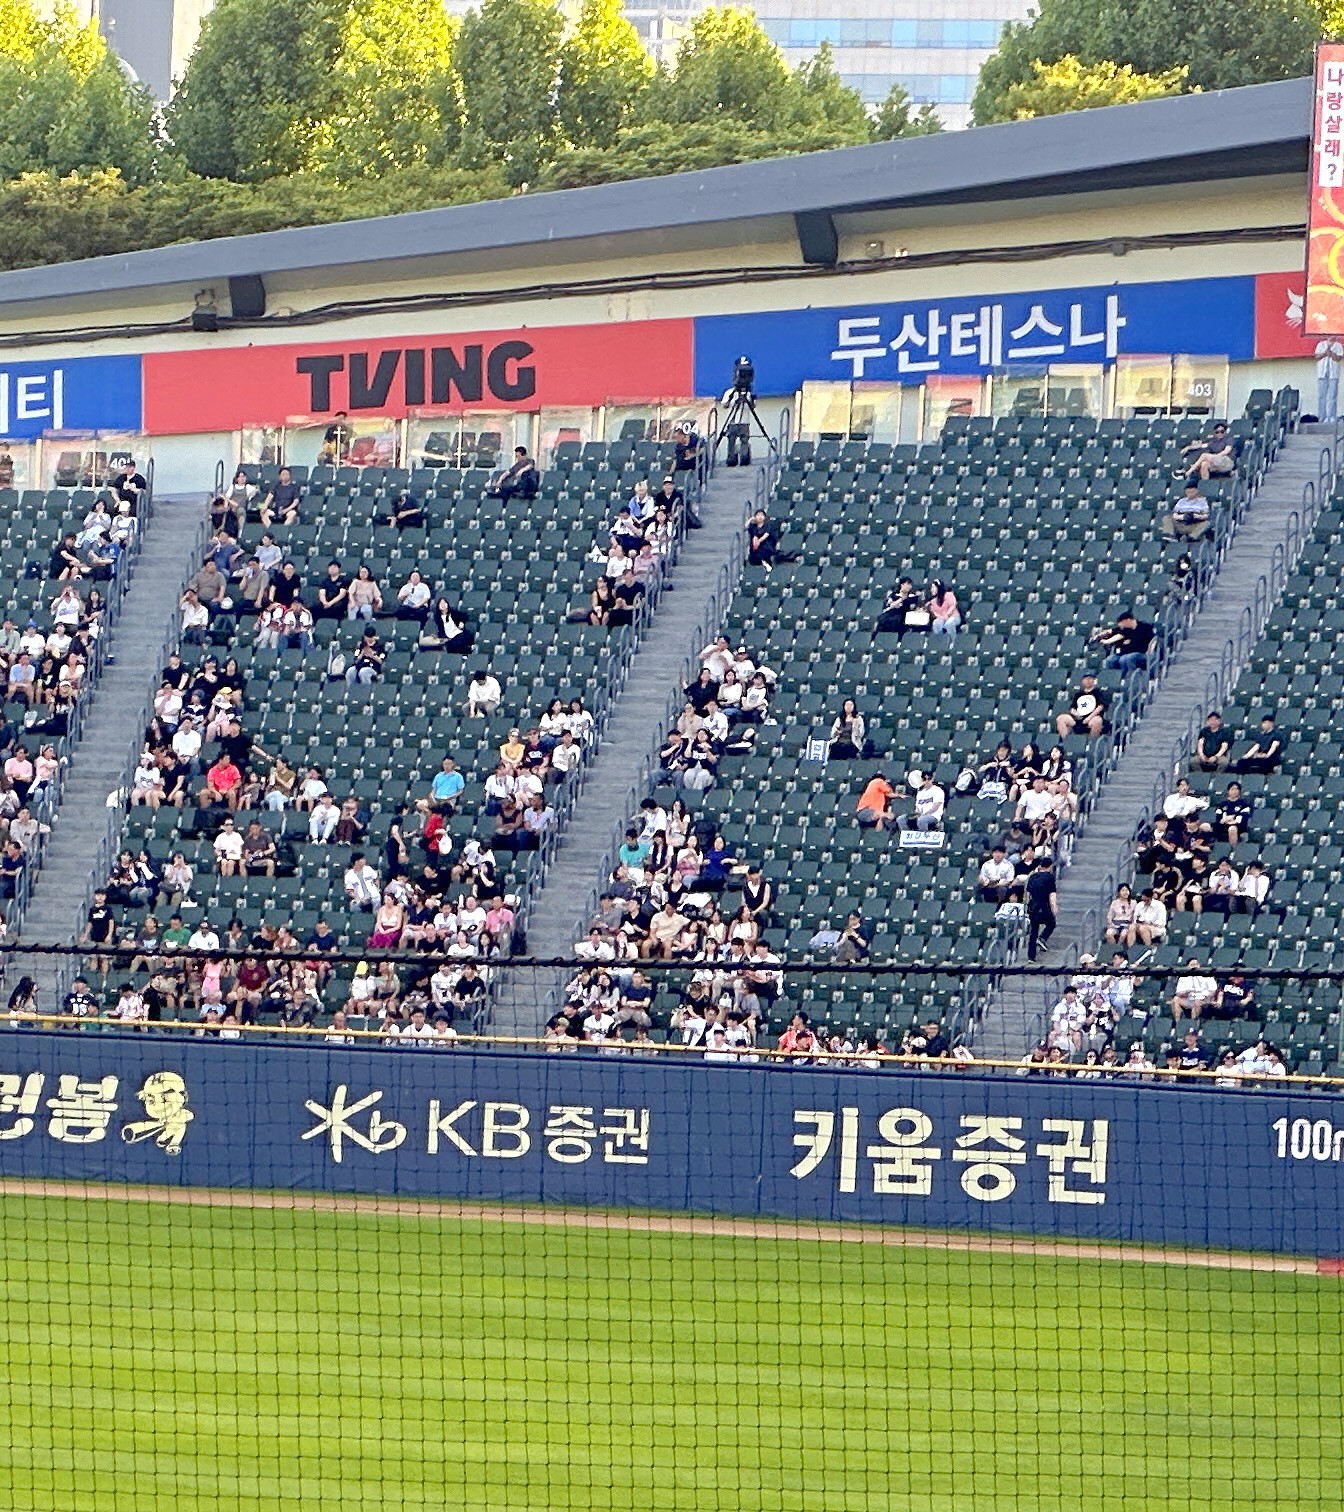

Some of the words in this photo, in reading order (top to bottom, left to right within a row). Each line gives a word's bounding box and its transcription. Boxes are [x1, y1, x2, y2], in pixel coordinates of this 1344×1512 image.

[831, 296, 1127, 377] 두산테스나
[296, 340, 536, 412] TVING
[1187, 383, 1212, 397] 403
[109, 457, 131, 470] 40
[426, 1099, 651, 1165] KB증권
[789, 1107, 1109, 1204] 키움증권
